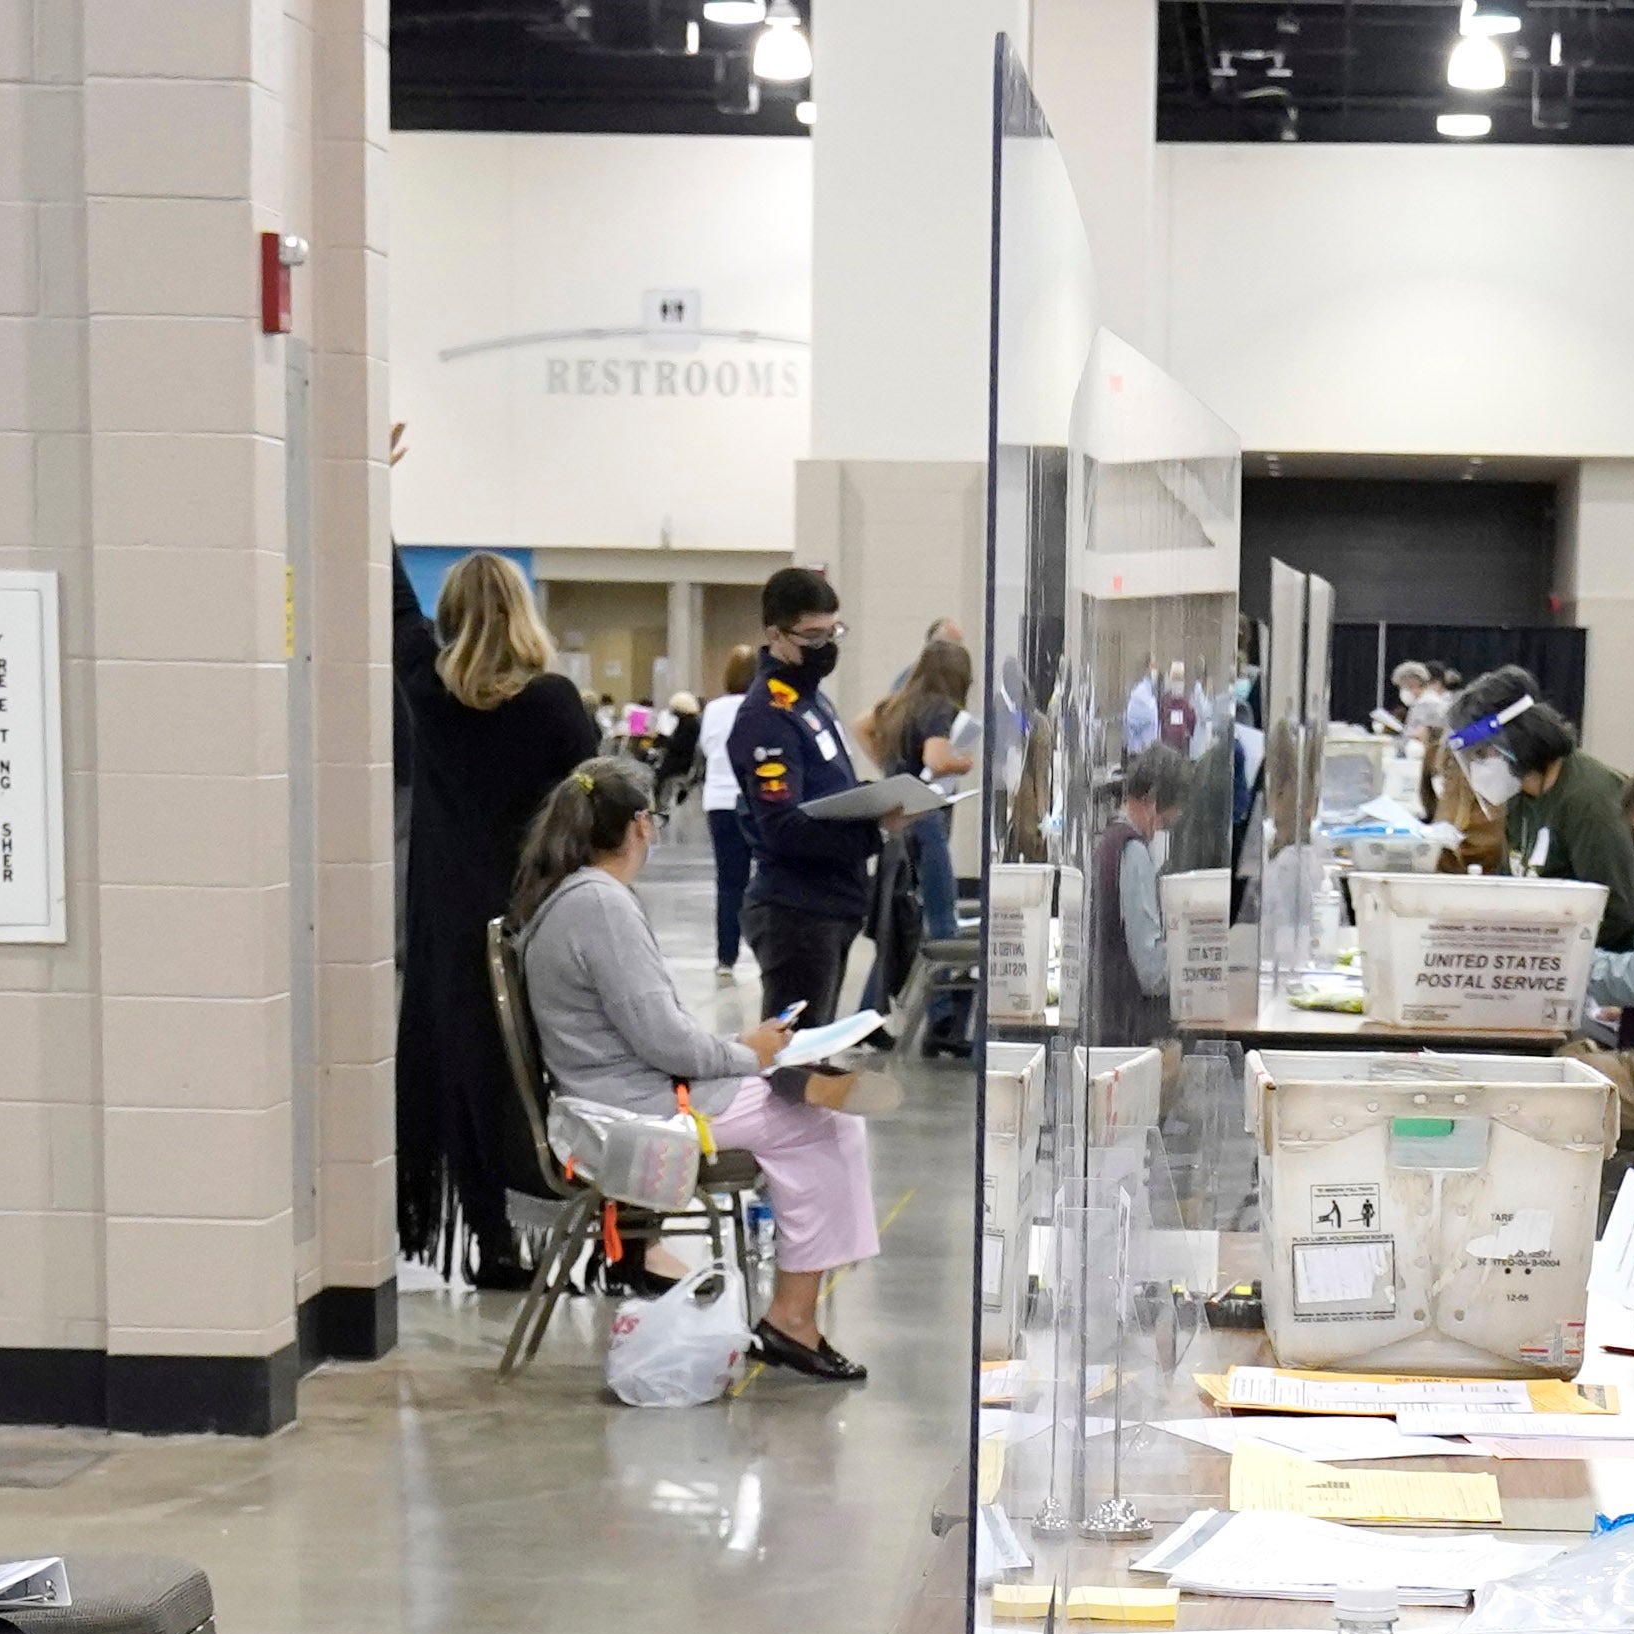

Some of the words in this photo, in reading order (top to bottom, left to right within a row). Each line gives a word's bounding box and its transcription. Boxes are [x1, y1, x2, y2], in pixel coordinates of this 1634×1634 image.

[545, 358, 800, 398] RESTROOMS
[1424, 953, 1488, 968] UNITED
[1493, 956, 1561, 971] STATES
[1416, 973, 1486, 988] POSTAL
[1491, 976, 1568, 991] SERVICE
